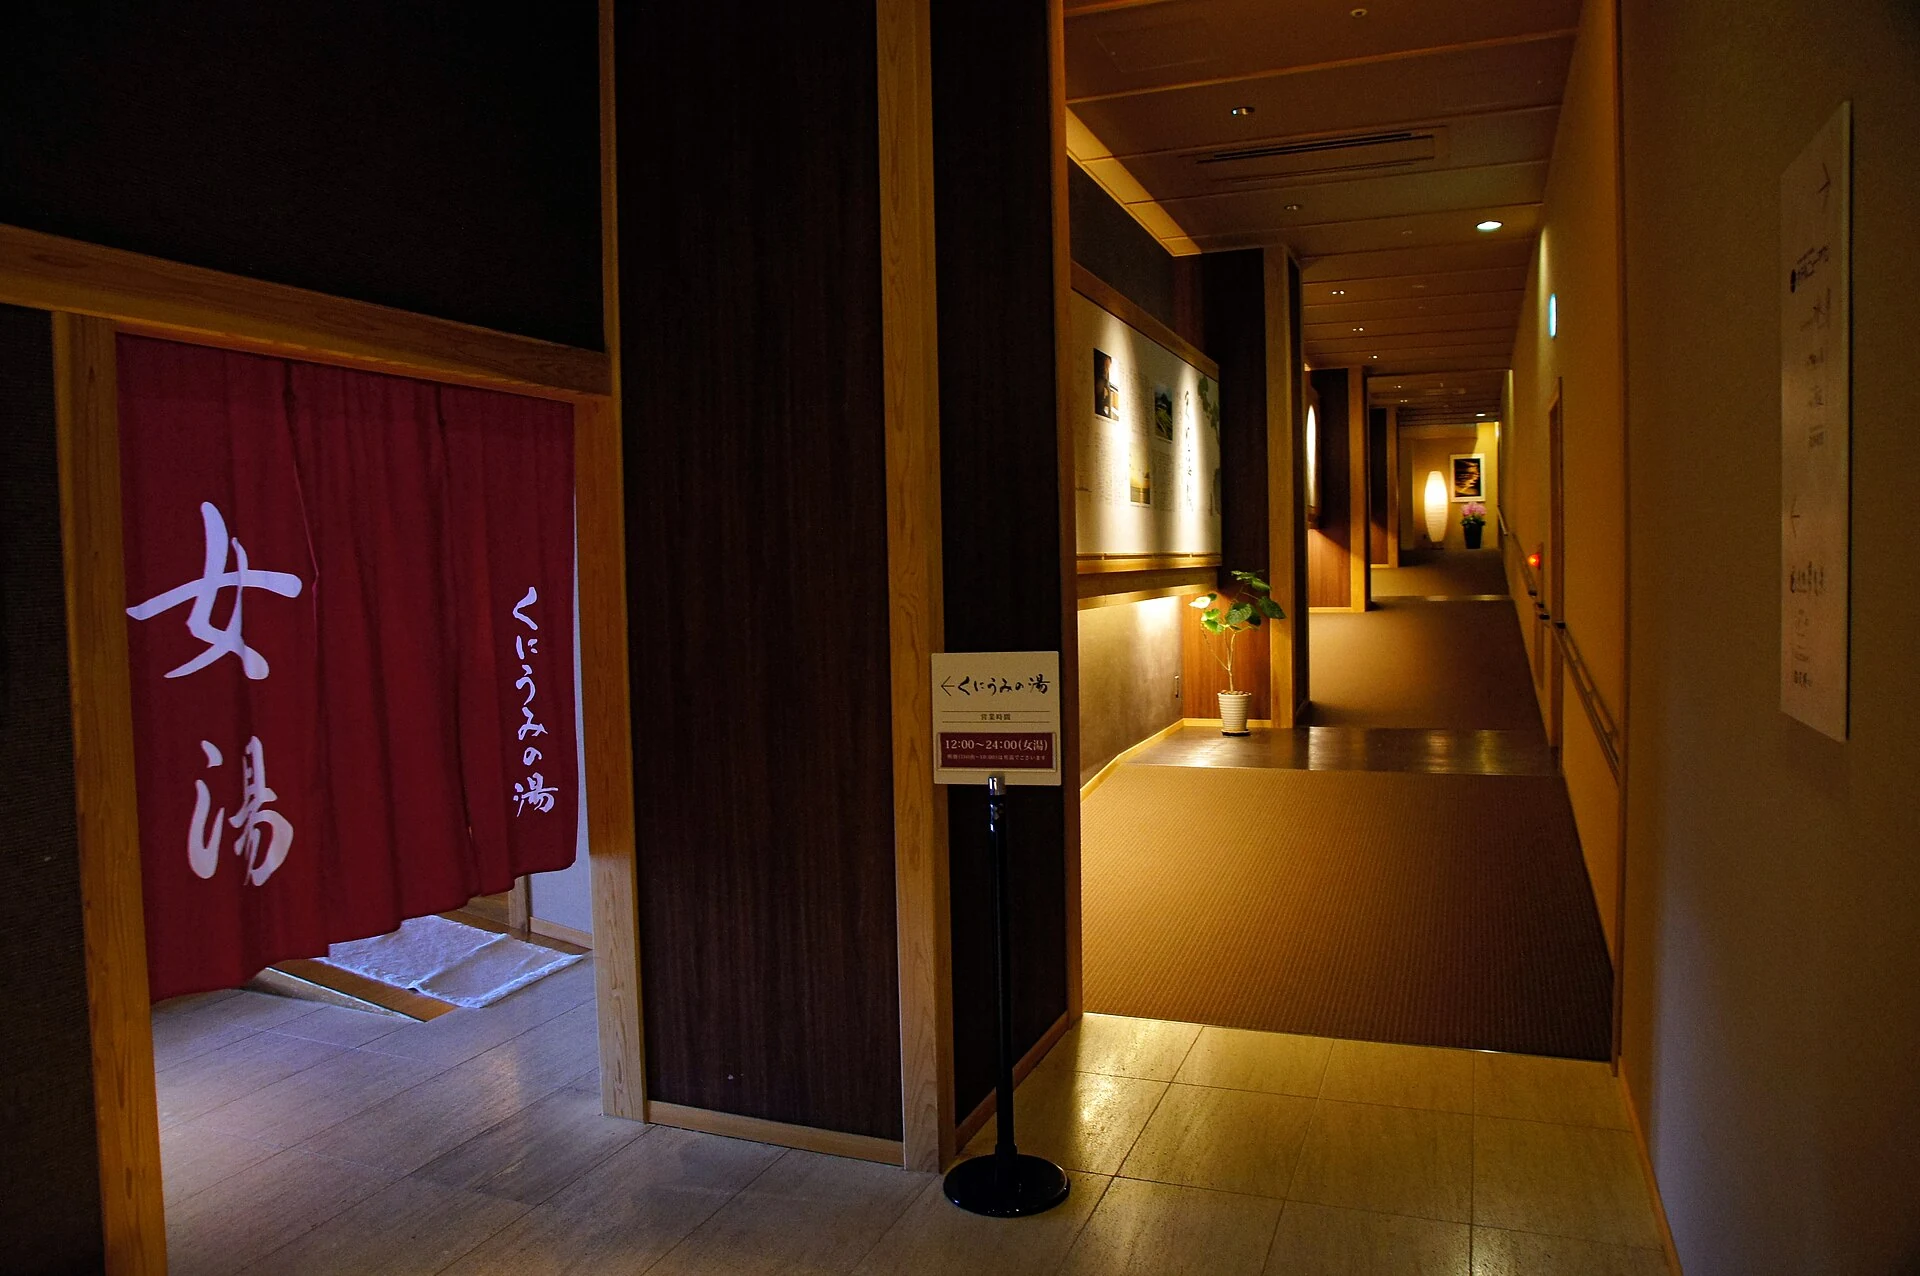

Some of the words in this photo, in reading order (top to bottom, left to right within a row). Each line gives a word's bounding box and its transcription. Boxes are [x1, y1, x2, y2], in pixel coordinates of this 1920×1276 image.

[125, 501, 302, 886] 女湯
[512, 586, 559, 817] くにうみの湯
[957, 673, 1051, 696] くにうみの湯
